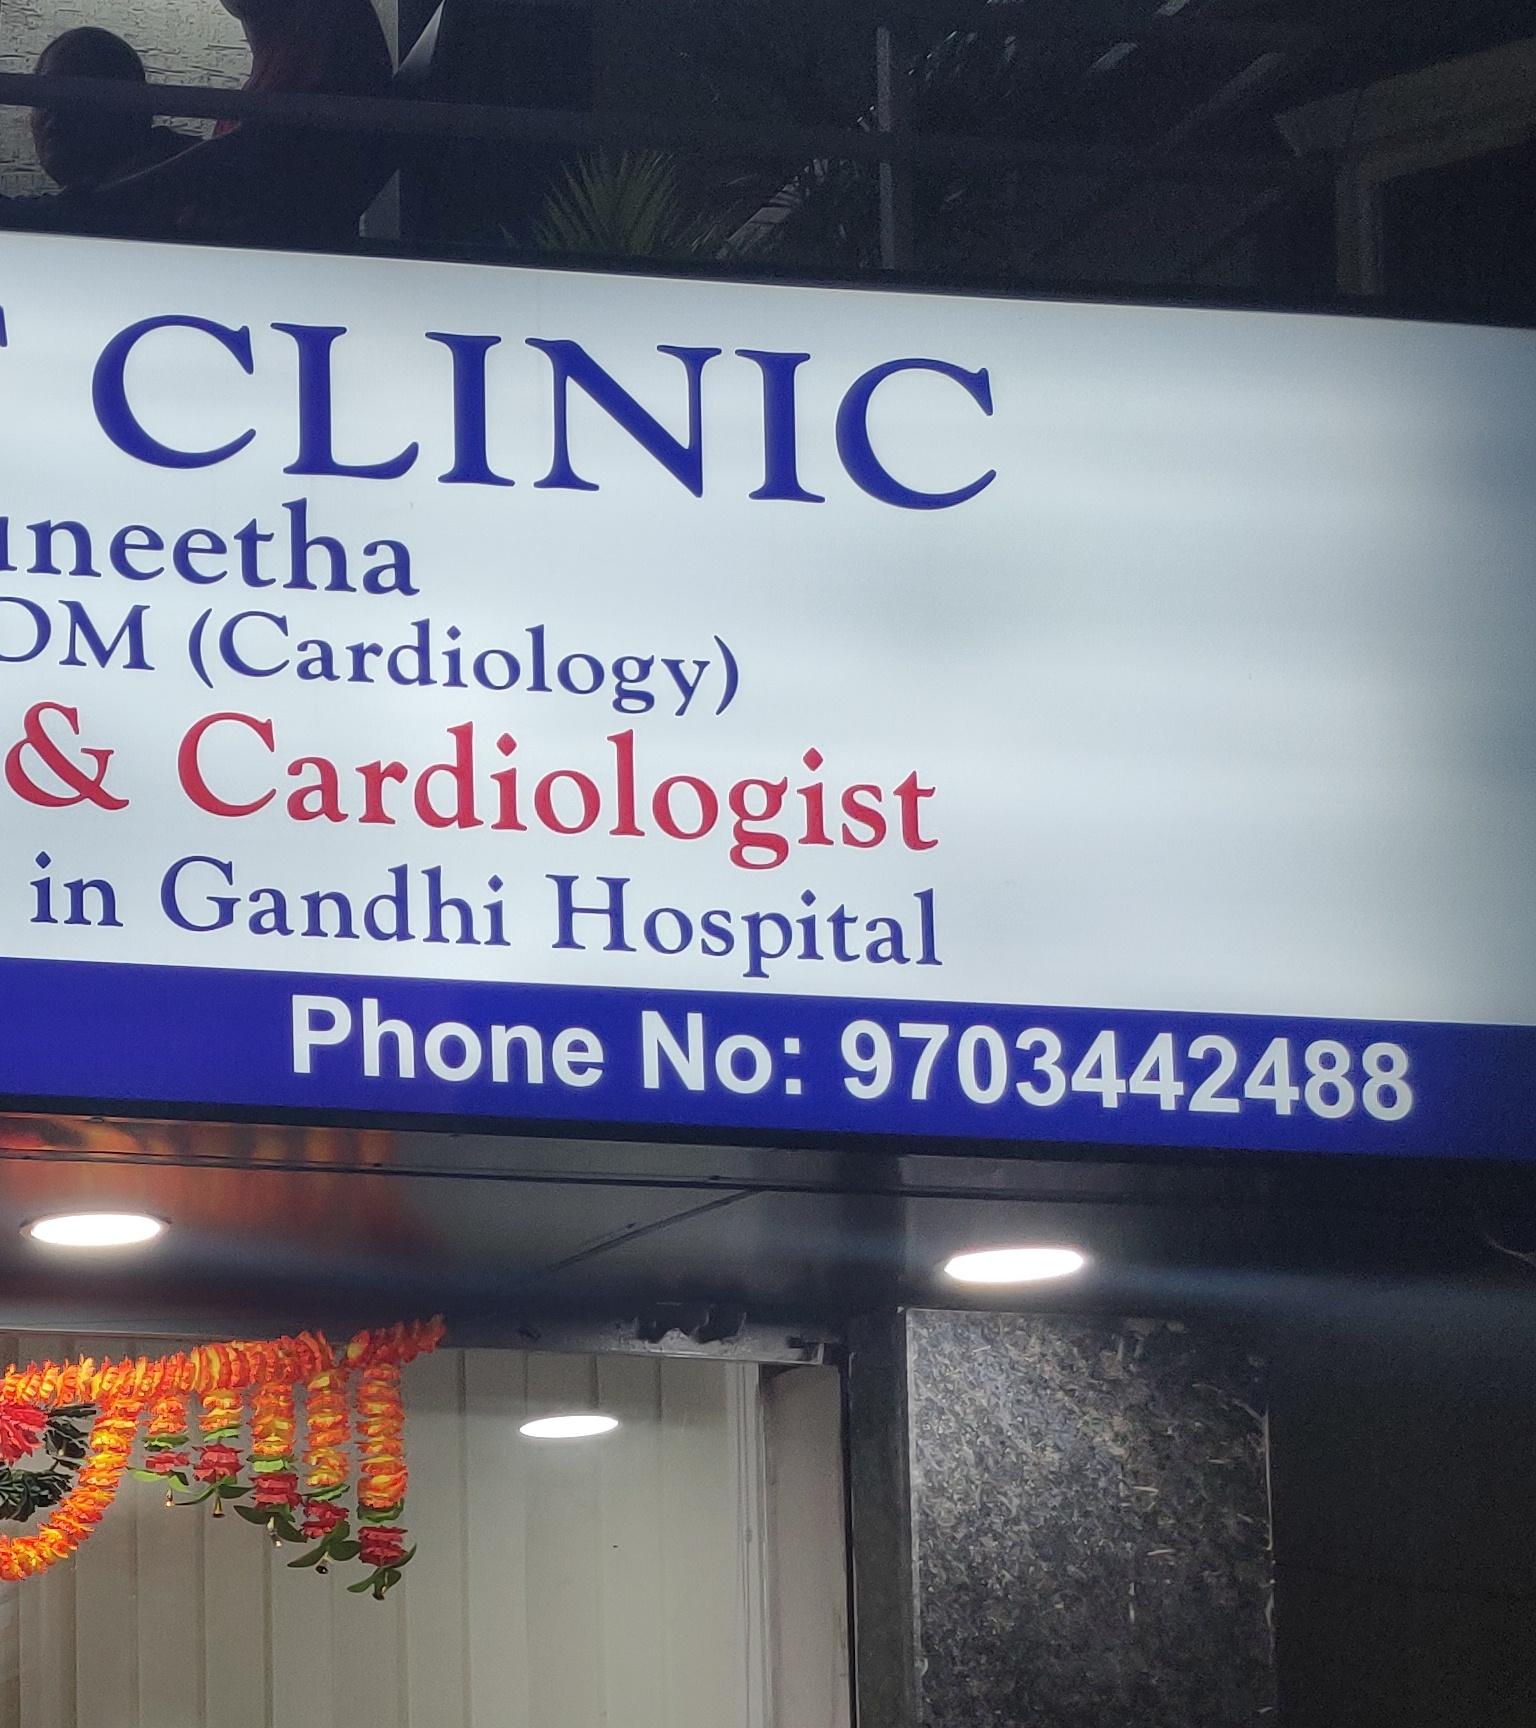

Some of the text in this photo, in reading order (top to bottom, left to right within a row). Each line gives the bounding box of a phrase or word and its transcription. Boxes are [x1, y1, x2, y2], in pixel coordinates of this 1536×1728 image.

[90, 313, 998, 512] CLINIC
[187, 607, 740, 718] (Cardiology)
[3, 700, 131, 812] &
[176, 711, 940, 871] Cardiologist
[28, 850, 125, 929] in
[159, 854, 512, 948] Gandhi
[544, 873, 944, 980] Hospital
[291, 993, 1414, 1122] Phone No: 9703442488
